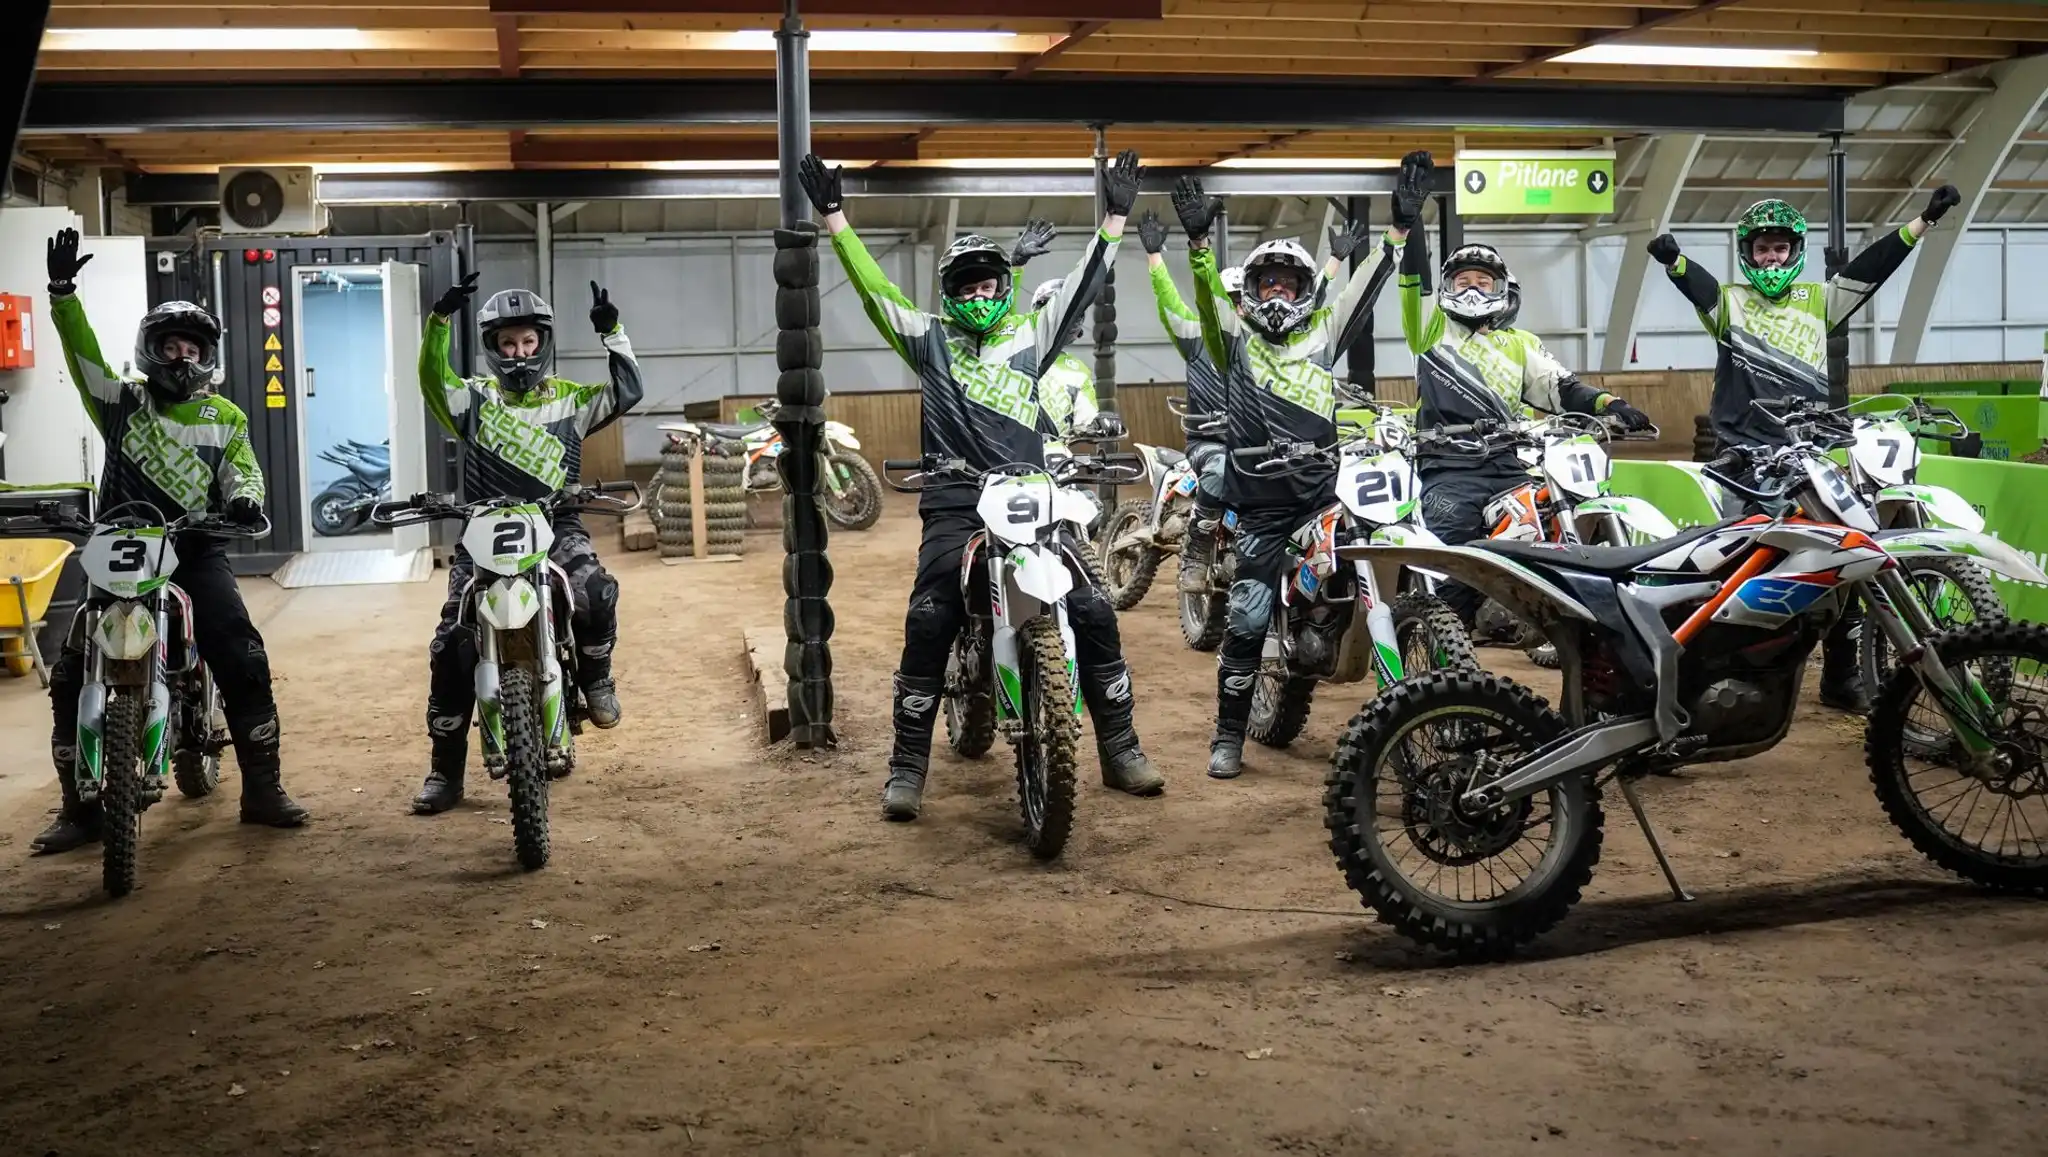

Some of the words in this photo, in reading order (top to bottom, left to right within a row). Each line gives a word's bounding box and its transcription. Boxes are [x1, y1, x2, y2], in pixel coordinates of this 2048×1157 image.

[1498, 161, 1579, 188] Pitlane
[1450, 384, 1463, 395] your
[199, 405, 219, 420] 12
[1566, 453, 1595, 483] 11
[1877, 439, 1900, 468] 7
[1355, 470, 1402, 506] 21
[1007, 493, 1039, 524] 9
[493, 521, 526, 555] 2
[109, 540, 147, 572] 3
